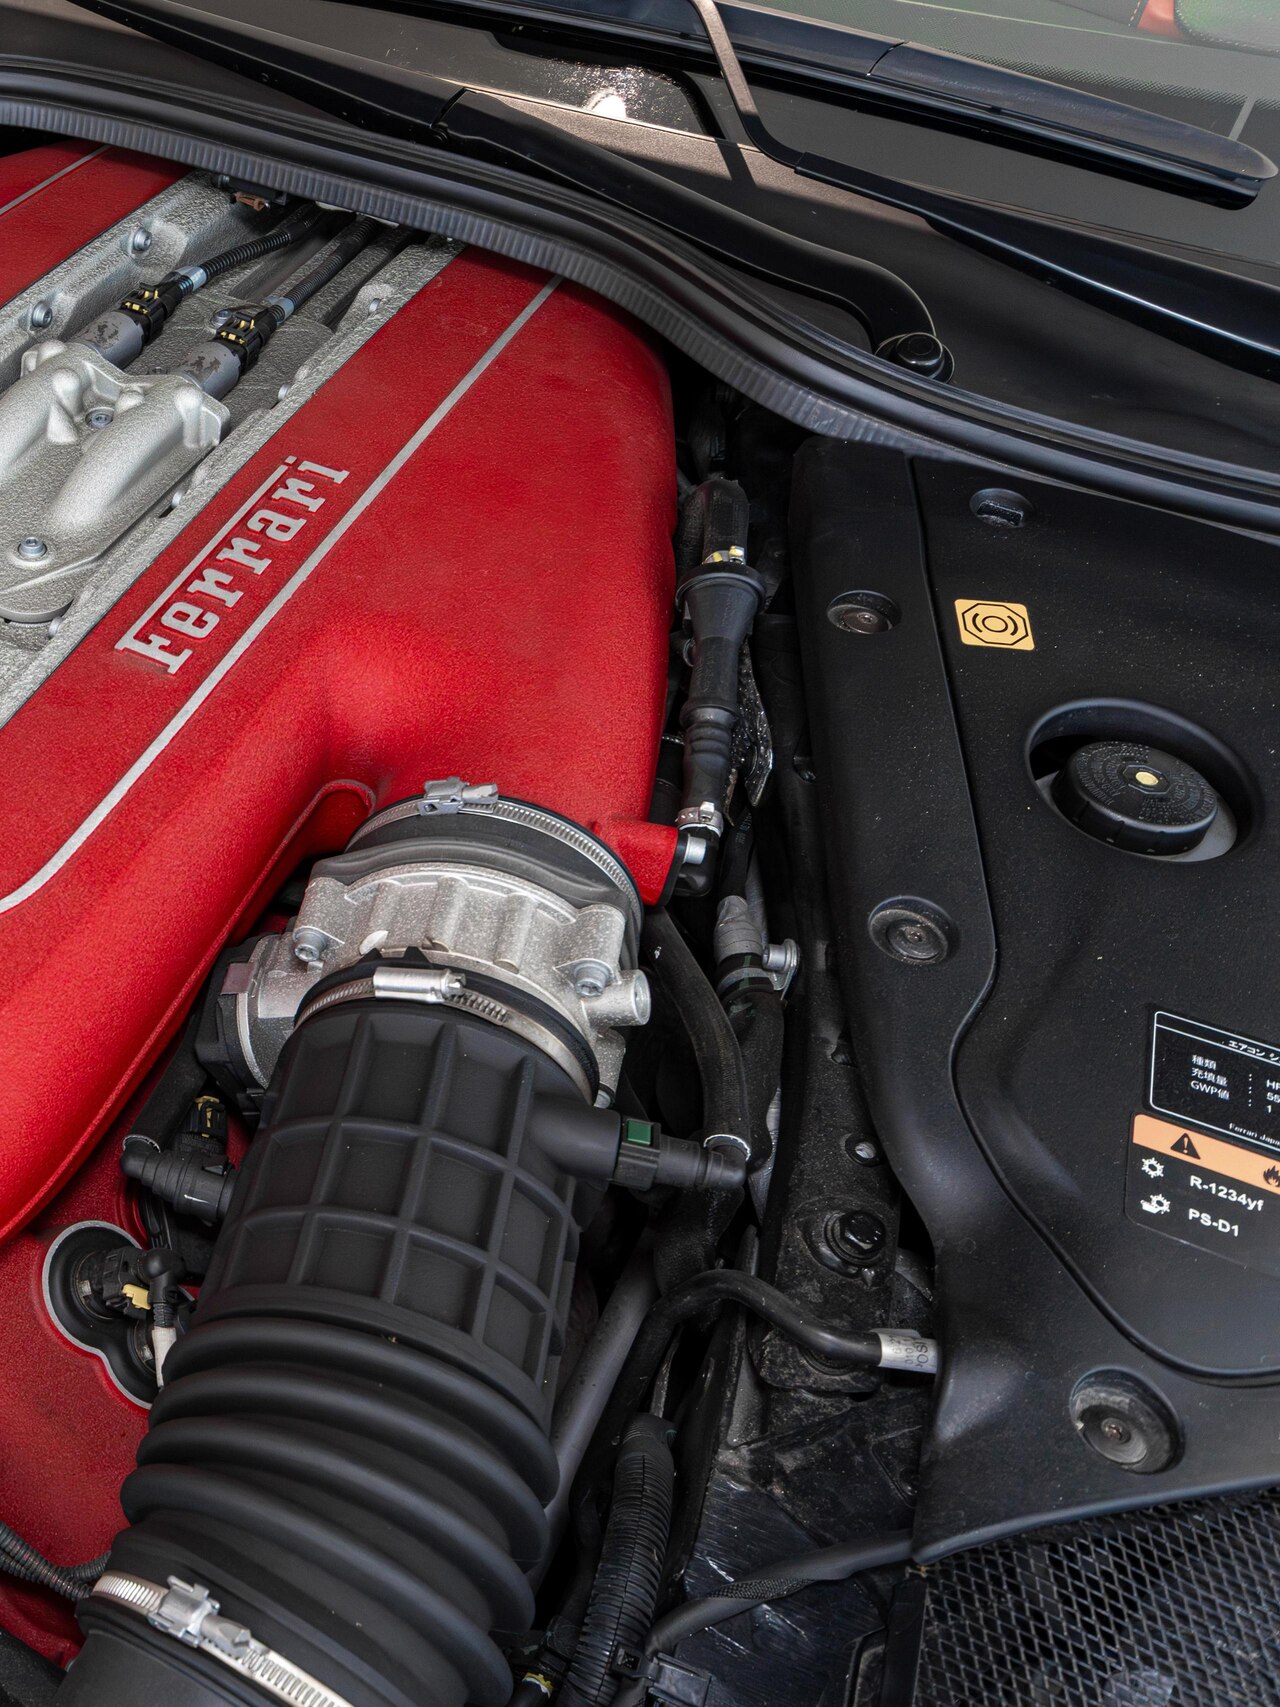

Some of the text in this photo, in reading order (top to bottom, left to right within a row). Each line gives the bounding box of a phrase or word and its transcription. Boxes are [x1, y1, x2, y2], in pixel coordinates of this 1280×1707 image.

[114, 455, 350, 675] Ferrari
[1228, 1039, 1265, 1057] エアコン
[1191, 1054, 1217, 1071] 種類
[1190, 1080, 1230, 1101] GWP値
[1228, 1122, 1258, 1138] Ferrari
[1189, 1175, 1264, 1211] R-1234yf
[1188, 1208, 1239, 1237] PS-D1
